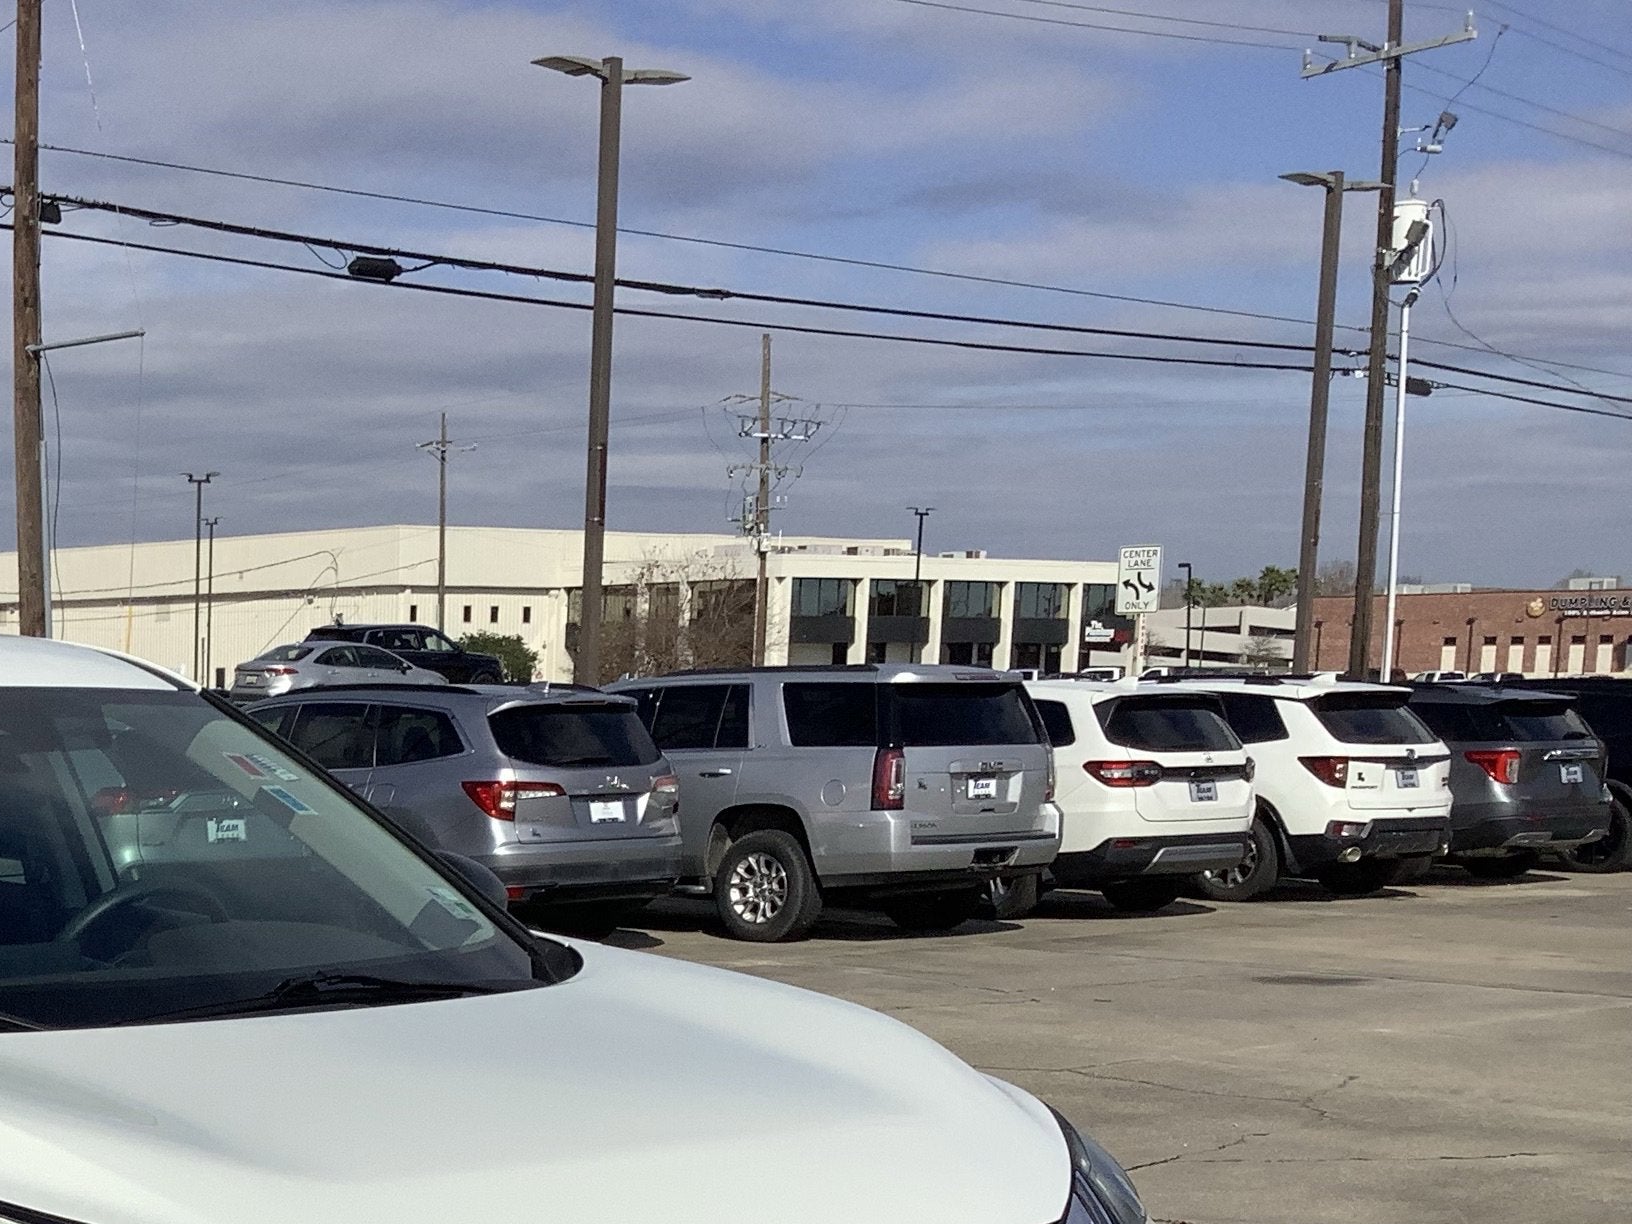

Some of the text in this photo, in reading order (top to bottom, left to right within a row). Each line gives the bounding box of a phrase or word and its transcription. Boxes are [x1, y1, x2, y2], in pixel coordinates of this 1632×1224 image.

[1123, 549, 1158, 559] CENTER
[1128, 559, 1152, 568] LANE
[1125, 601, 1150, 610] ONLY
[1551, 596, 1631, 608] DUMPLING &
[216, 821, 239, 833] TEAM
